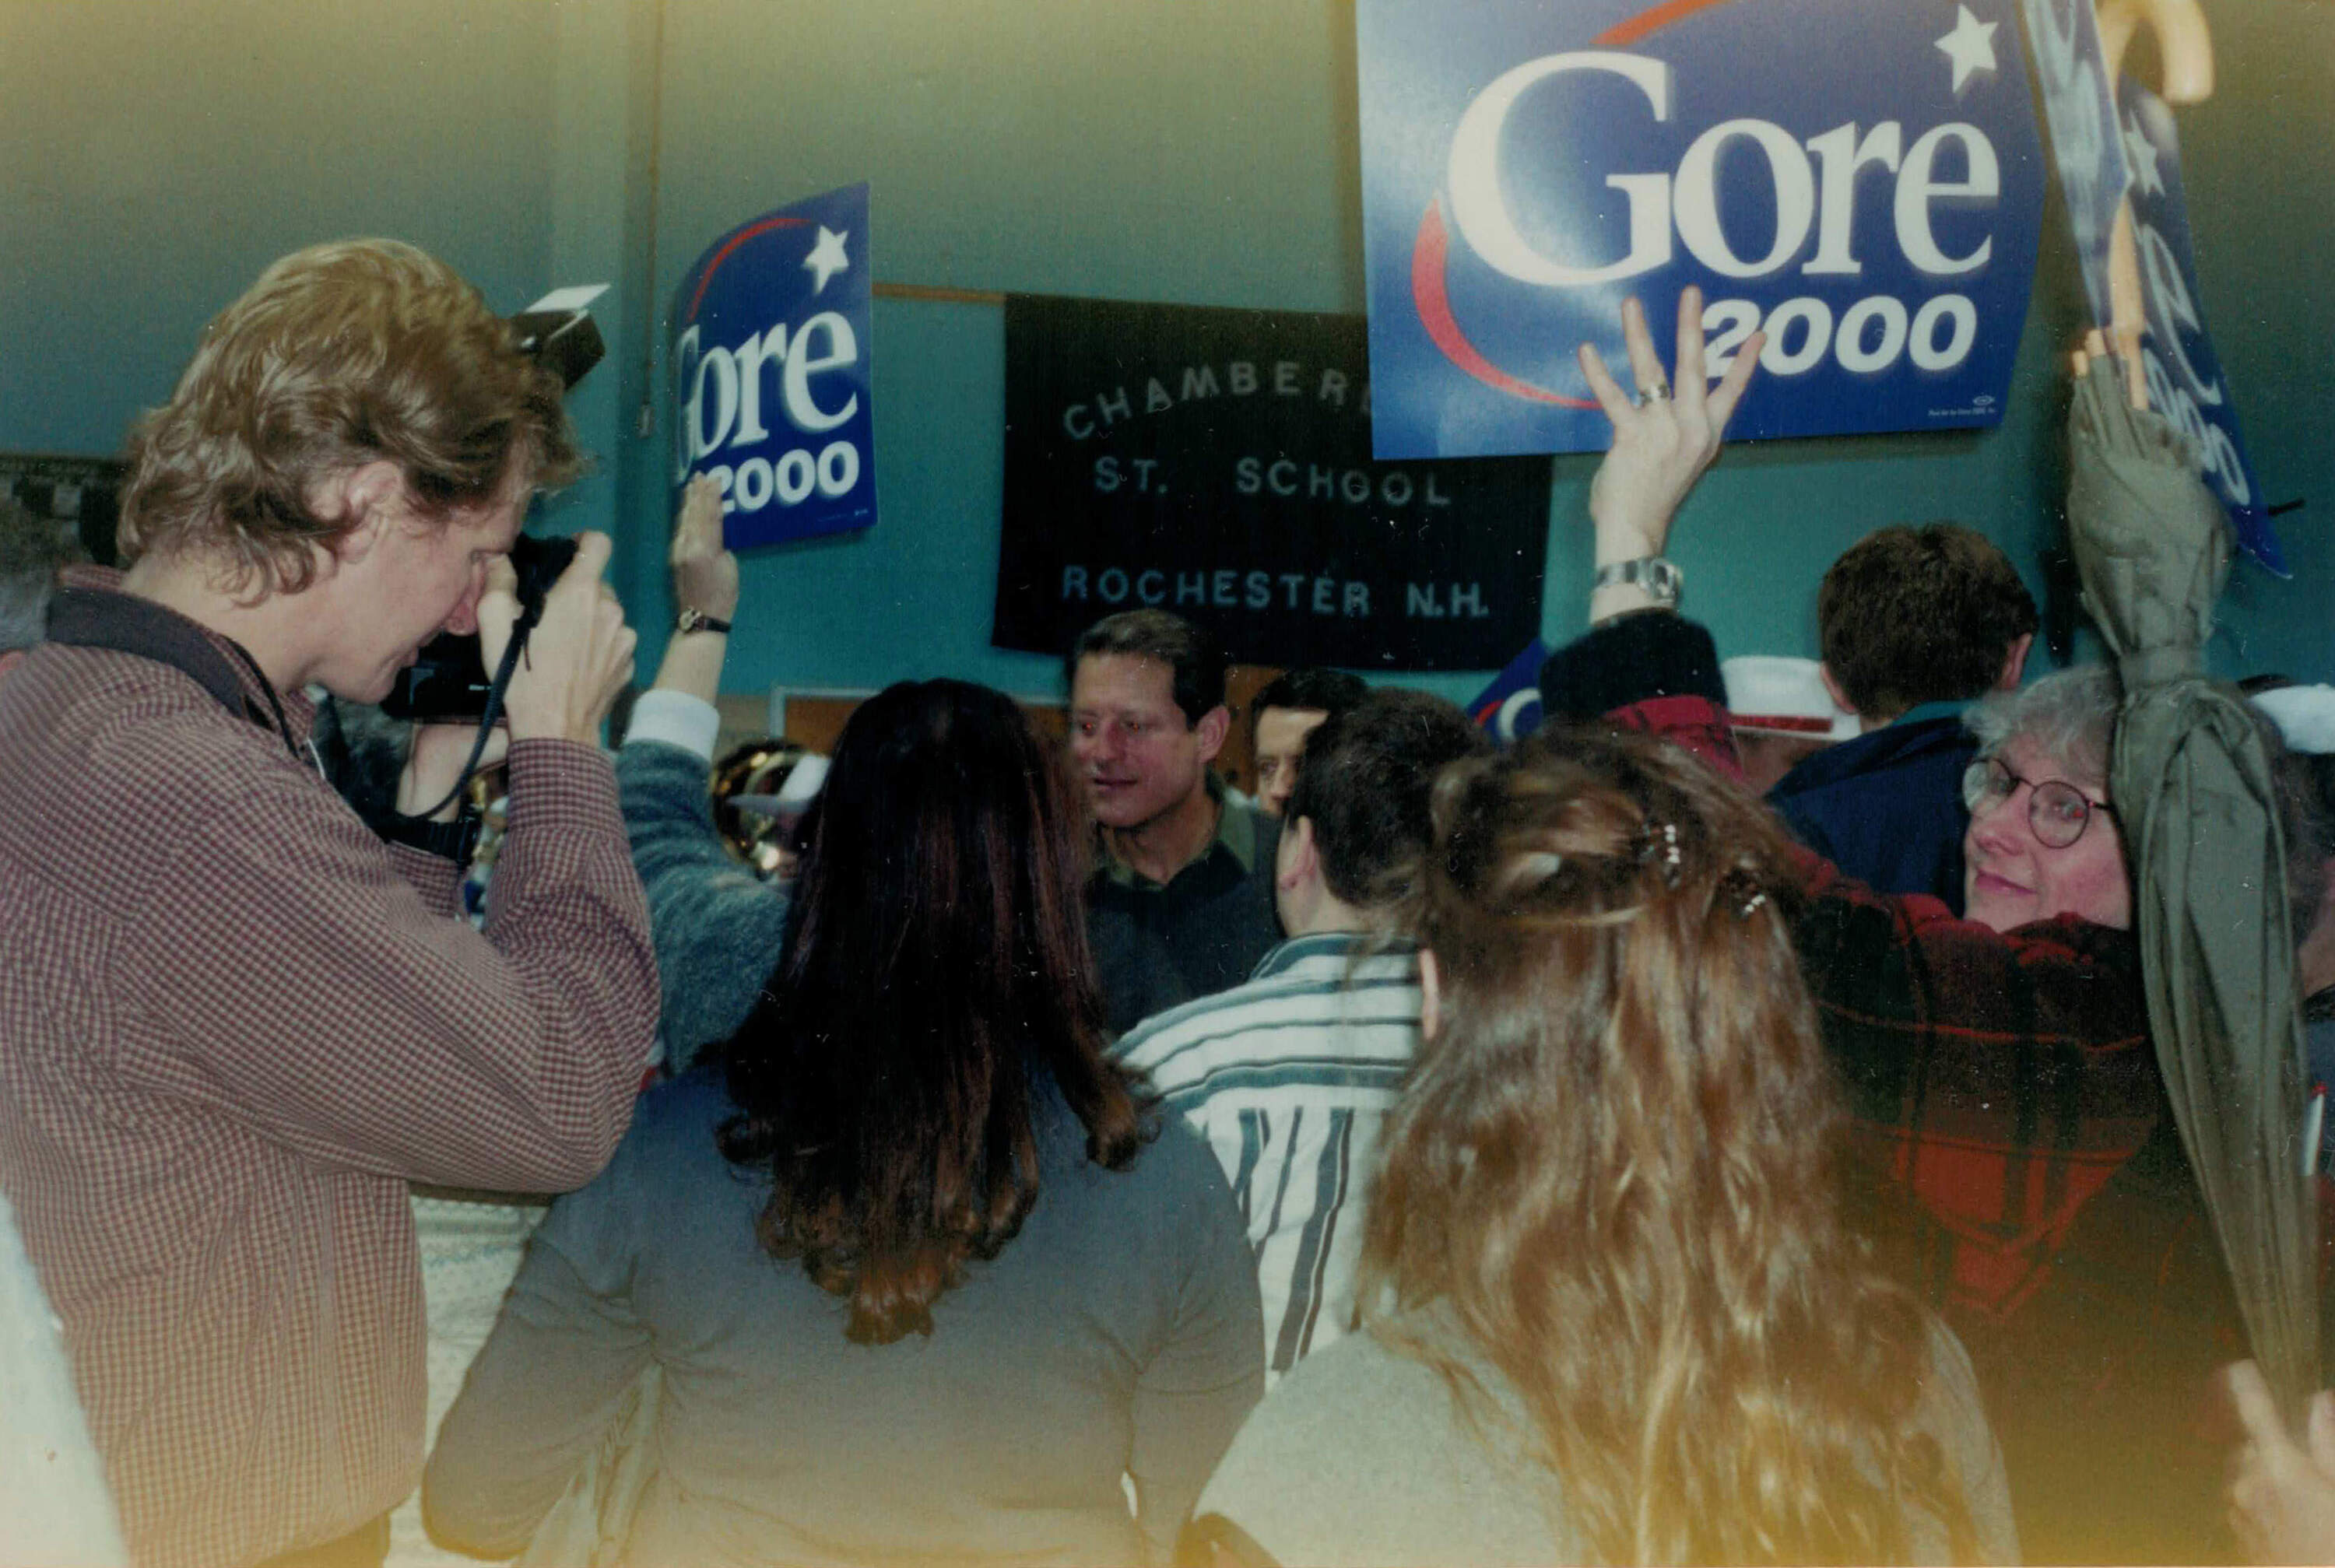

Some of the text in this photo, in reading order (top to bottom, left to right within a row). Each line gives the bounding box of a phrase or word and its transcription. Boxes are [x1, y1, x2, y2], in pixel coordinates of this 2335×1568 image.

[1448, 50, 2000, 286] Gore
[1700, 293, 1978, 379] 2000
[1063, 360, 1371, 440] CHAMBER
[1094, 456, 1452, 507] ST. SCHOOL
[1062, 565, 1490, 618] ROCHESTER N.H.
